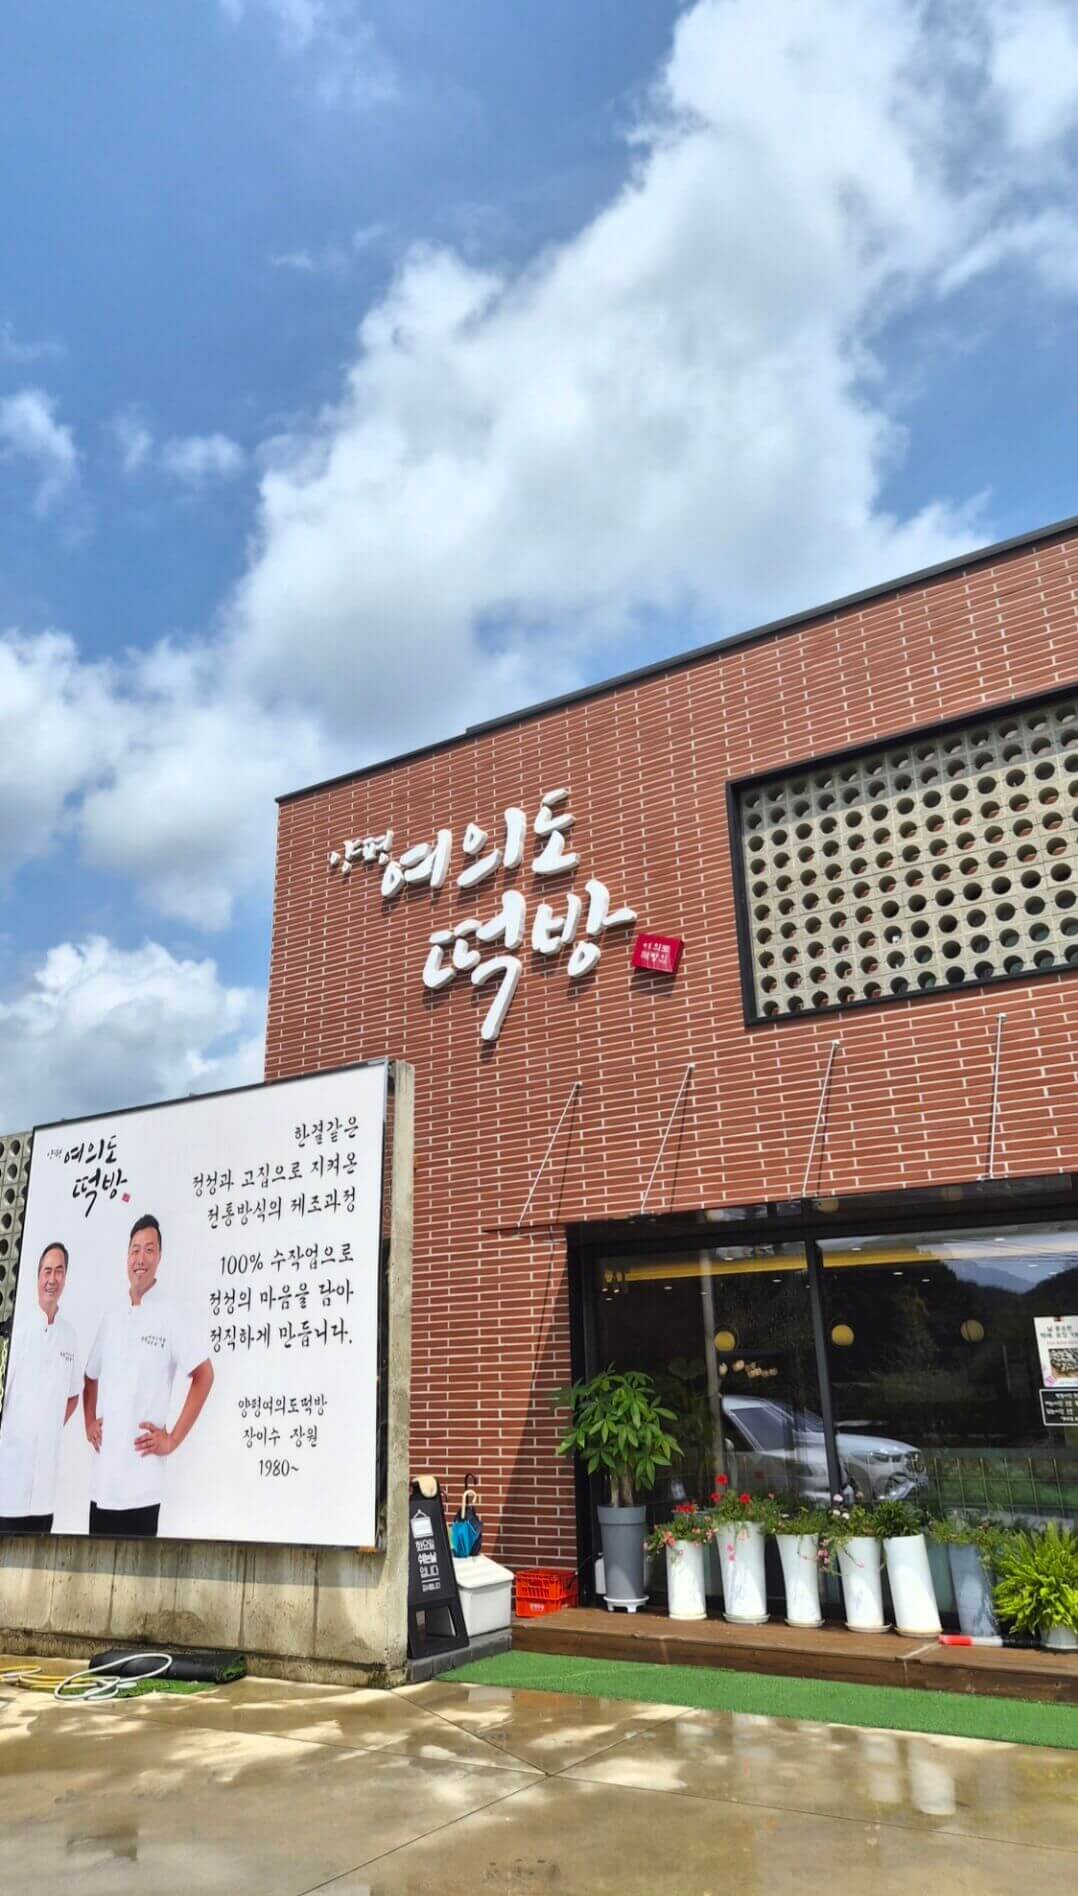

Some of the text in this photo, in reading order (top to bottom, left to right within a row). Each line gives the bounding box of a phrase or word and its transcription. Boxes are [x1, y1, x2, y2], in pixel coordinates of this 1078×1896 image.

[380, 788, 581, 898] 여의도
[423, 878, 638, 1041] 떡방
[63, 1135, 117, 1164] 여의도
[294, 1116, 359, 1147] 한결같은
[192, 1152, 358, 1197] 정성과 고집으로 지켜온
[72, 1168, 128, 1218] 떡방
[207, 1186, 356, 1229] 전통방식의 제조과정
[221, 1243, 354, 1276] 100% 수작업으로
[209, 1278, 354, 1316] 정성의 마음을 담아
[210, 1317, 353, 1353] 정직하게 만듭니다.
[238, 1393, 328, 1418] 양평여의도떡방
[243, 1425, 318, 1448] 장이수 장원
[259, 1458, 300, 1477] 1980~
